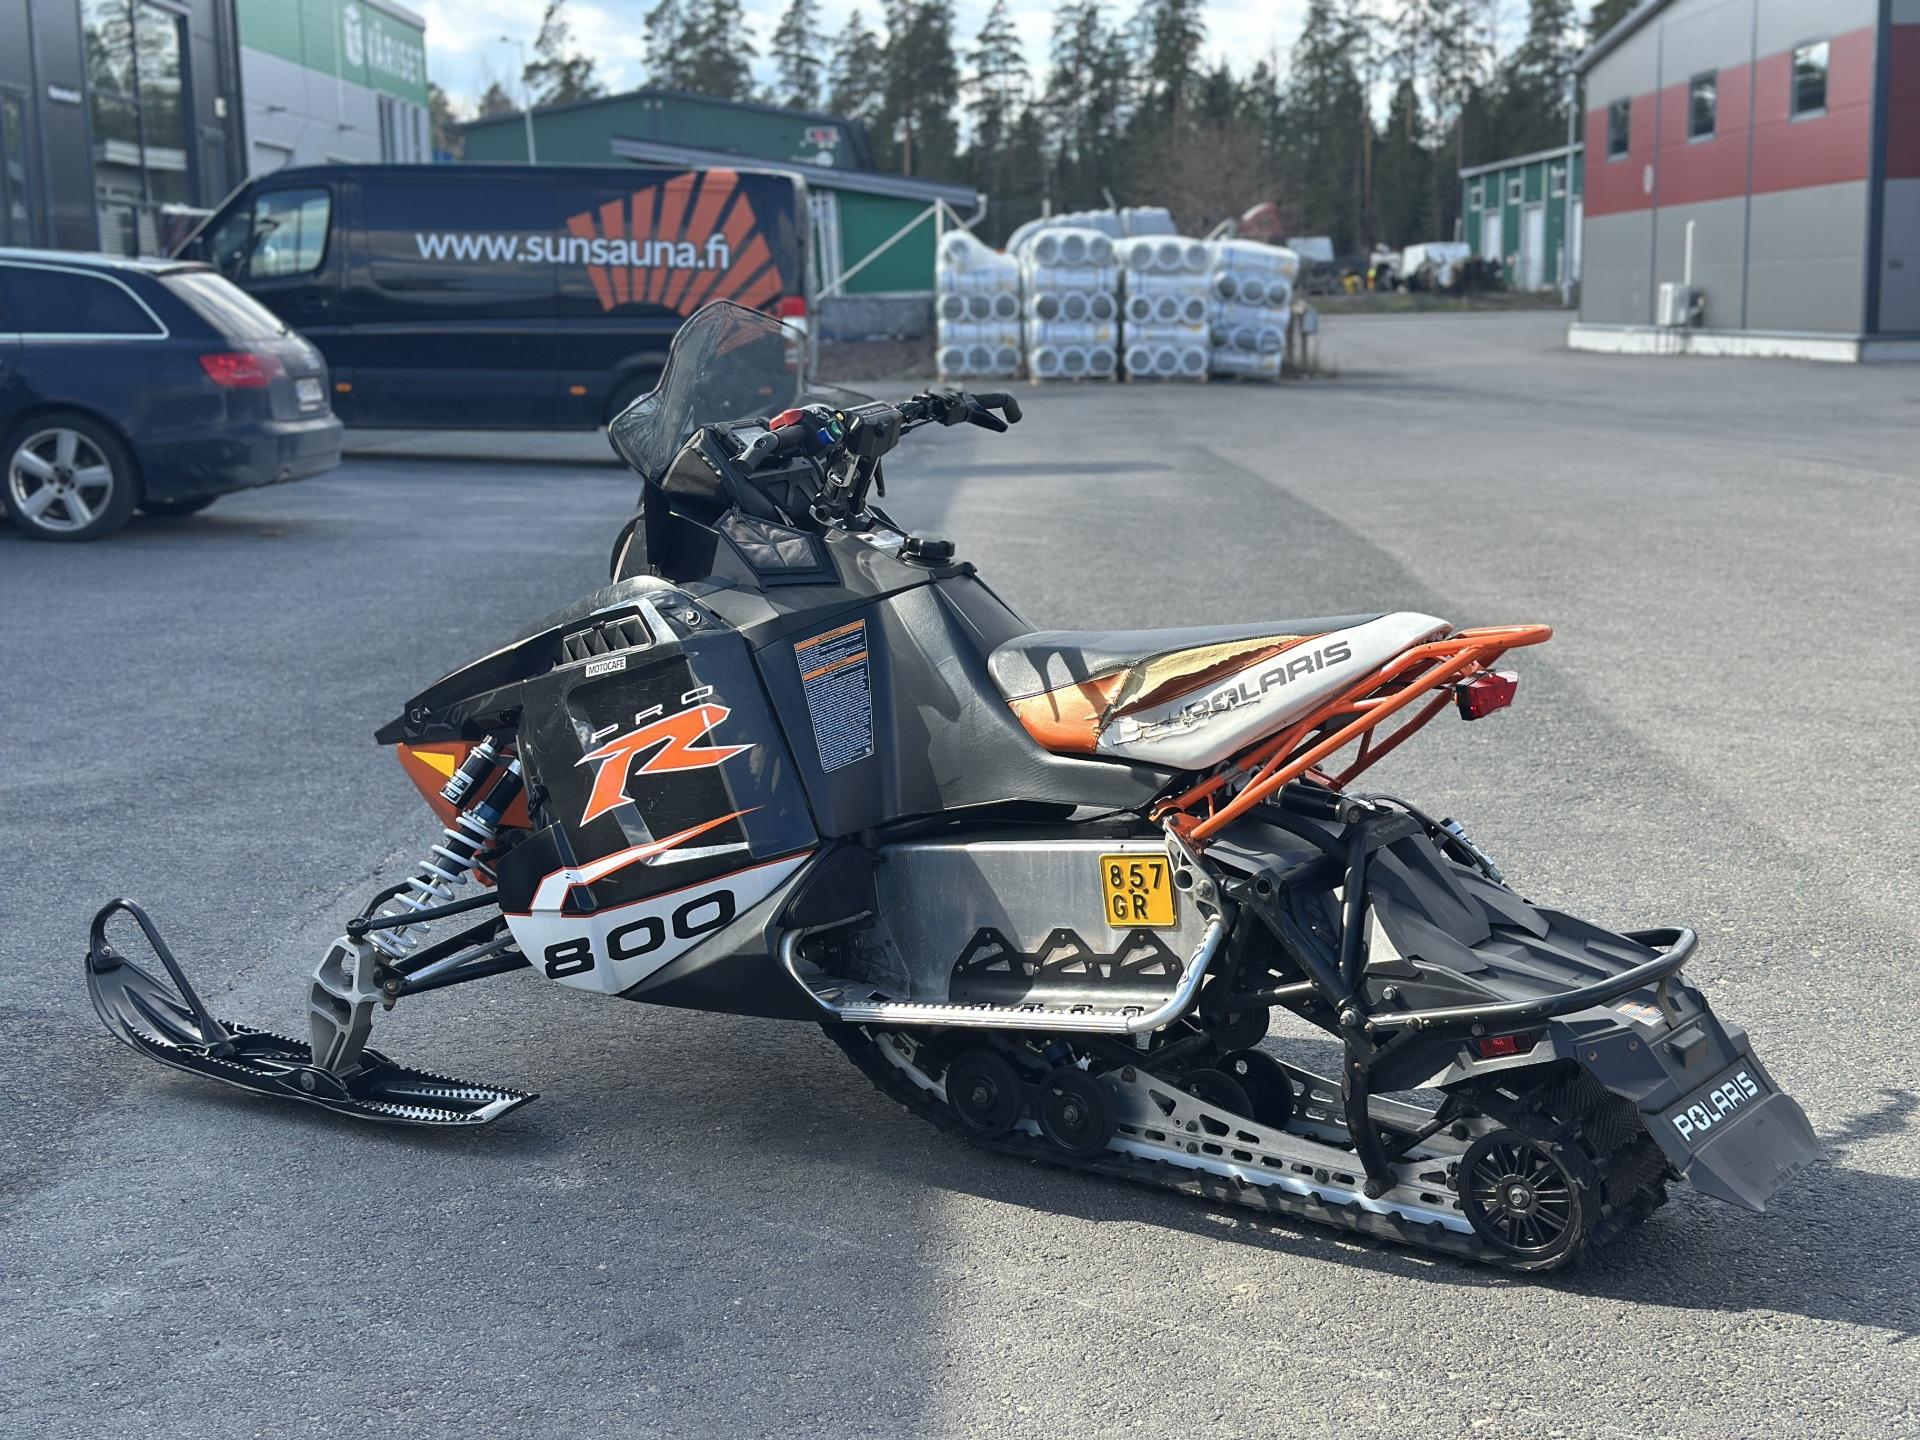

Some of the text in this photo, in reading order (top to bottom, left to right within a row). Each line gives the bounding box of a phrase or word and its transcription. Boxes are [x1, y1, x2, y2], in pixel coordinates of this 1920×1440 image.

[415, 232, 730, 270] www.sunsauna.fi
[587, 658, 625, 676] MOTOCAFE
[1184, 640, 1352, 719] POLARIS
[590, 684, 714, 744] PRO
[573, 702, 757, 828] R
[1110, 863, 1163, 890] 857
[1112, 893, 1149, 920] GR
[543, 889, 738, 980] 800
[1671, 1070, 1759, 1142] POLARIS
